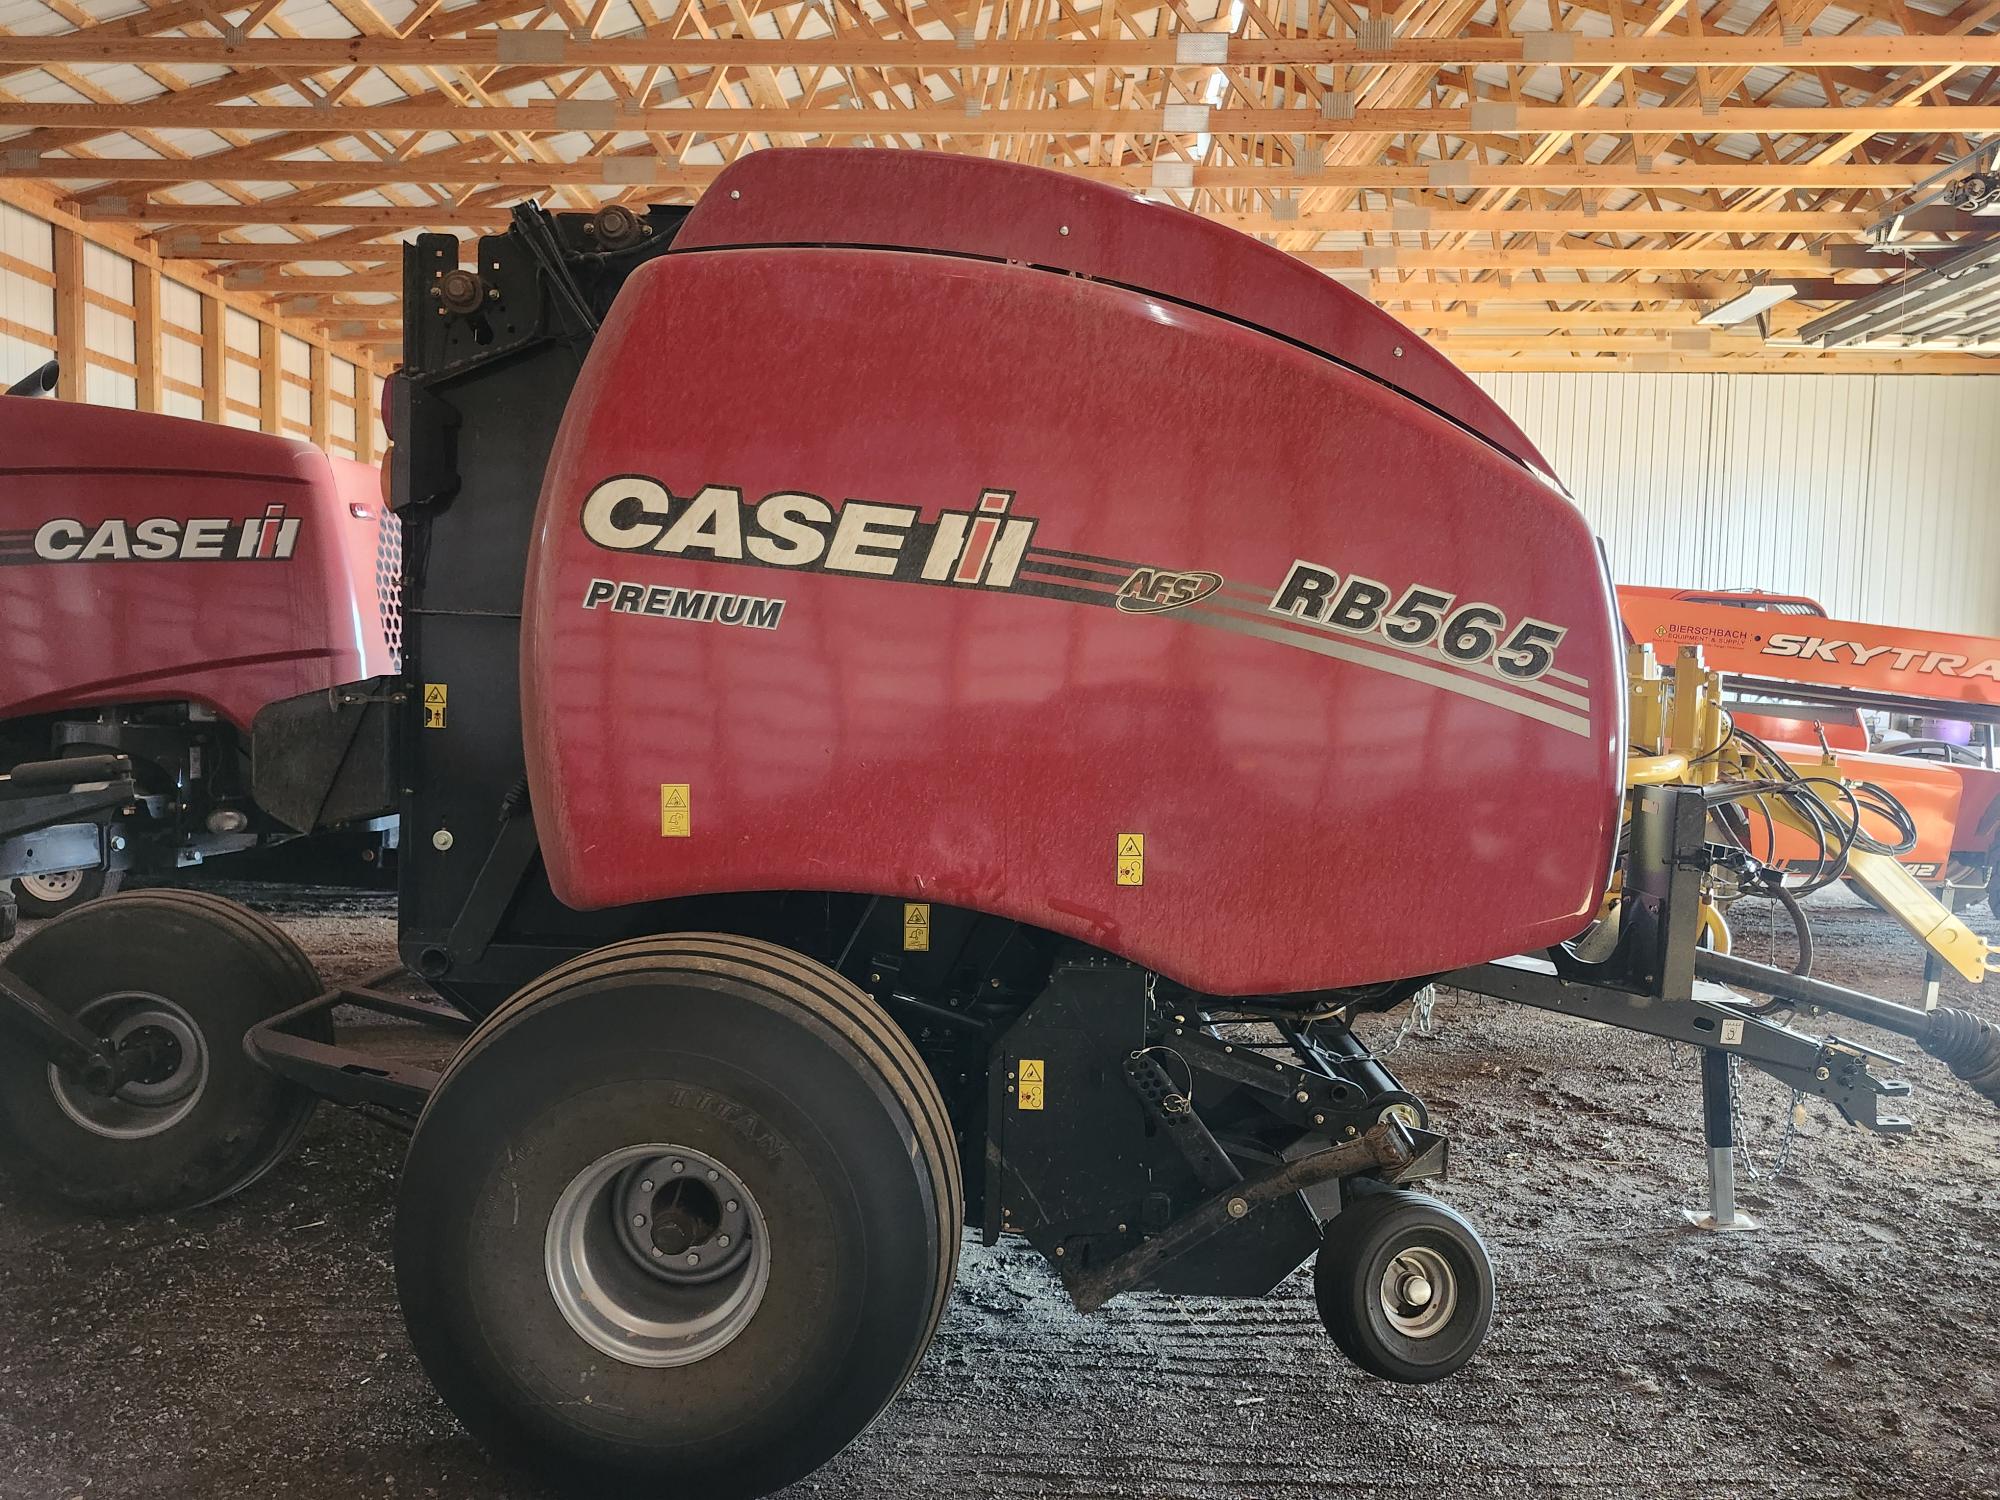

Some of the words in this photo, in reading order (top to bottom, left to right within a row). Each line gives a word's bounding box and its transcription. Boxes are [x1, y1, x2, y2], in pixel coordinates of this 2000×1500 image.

[34, 518, 231, 560] CASE
[580, 477, 917, 576] CASE
[583, 578, 786, 630] PREMIUM
[1115, 567, 1203, 606] AFS
[1268, 559, 1569, 682] RB565
[1667, 633, 1708, 642] EQUIPMENT
[1669, 624, 1748, 639] BIERSCHBACH
